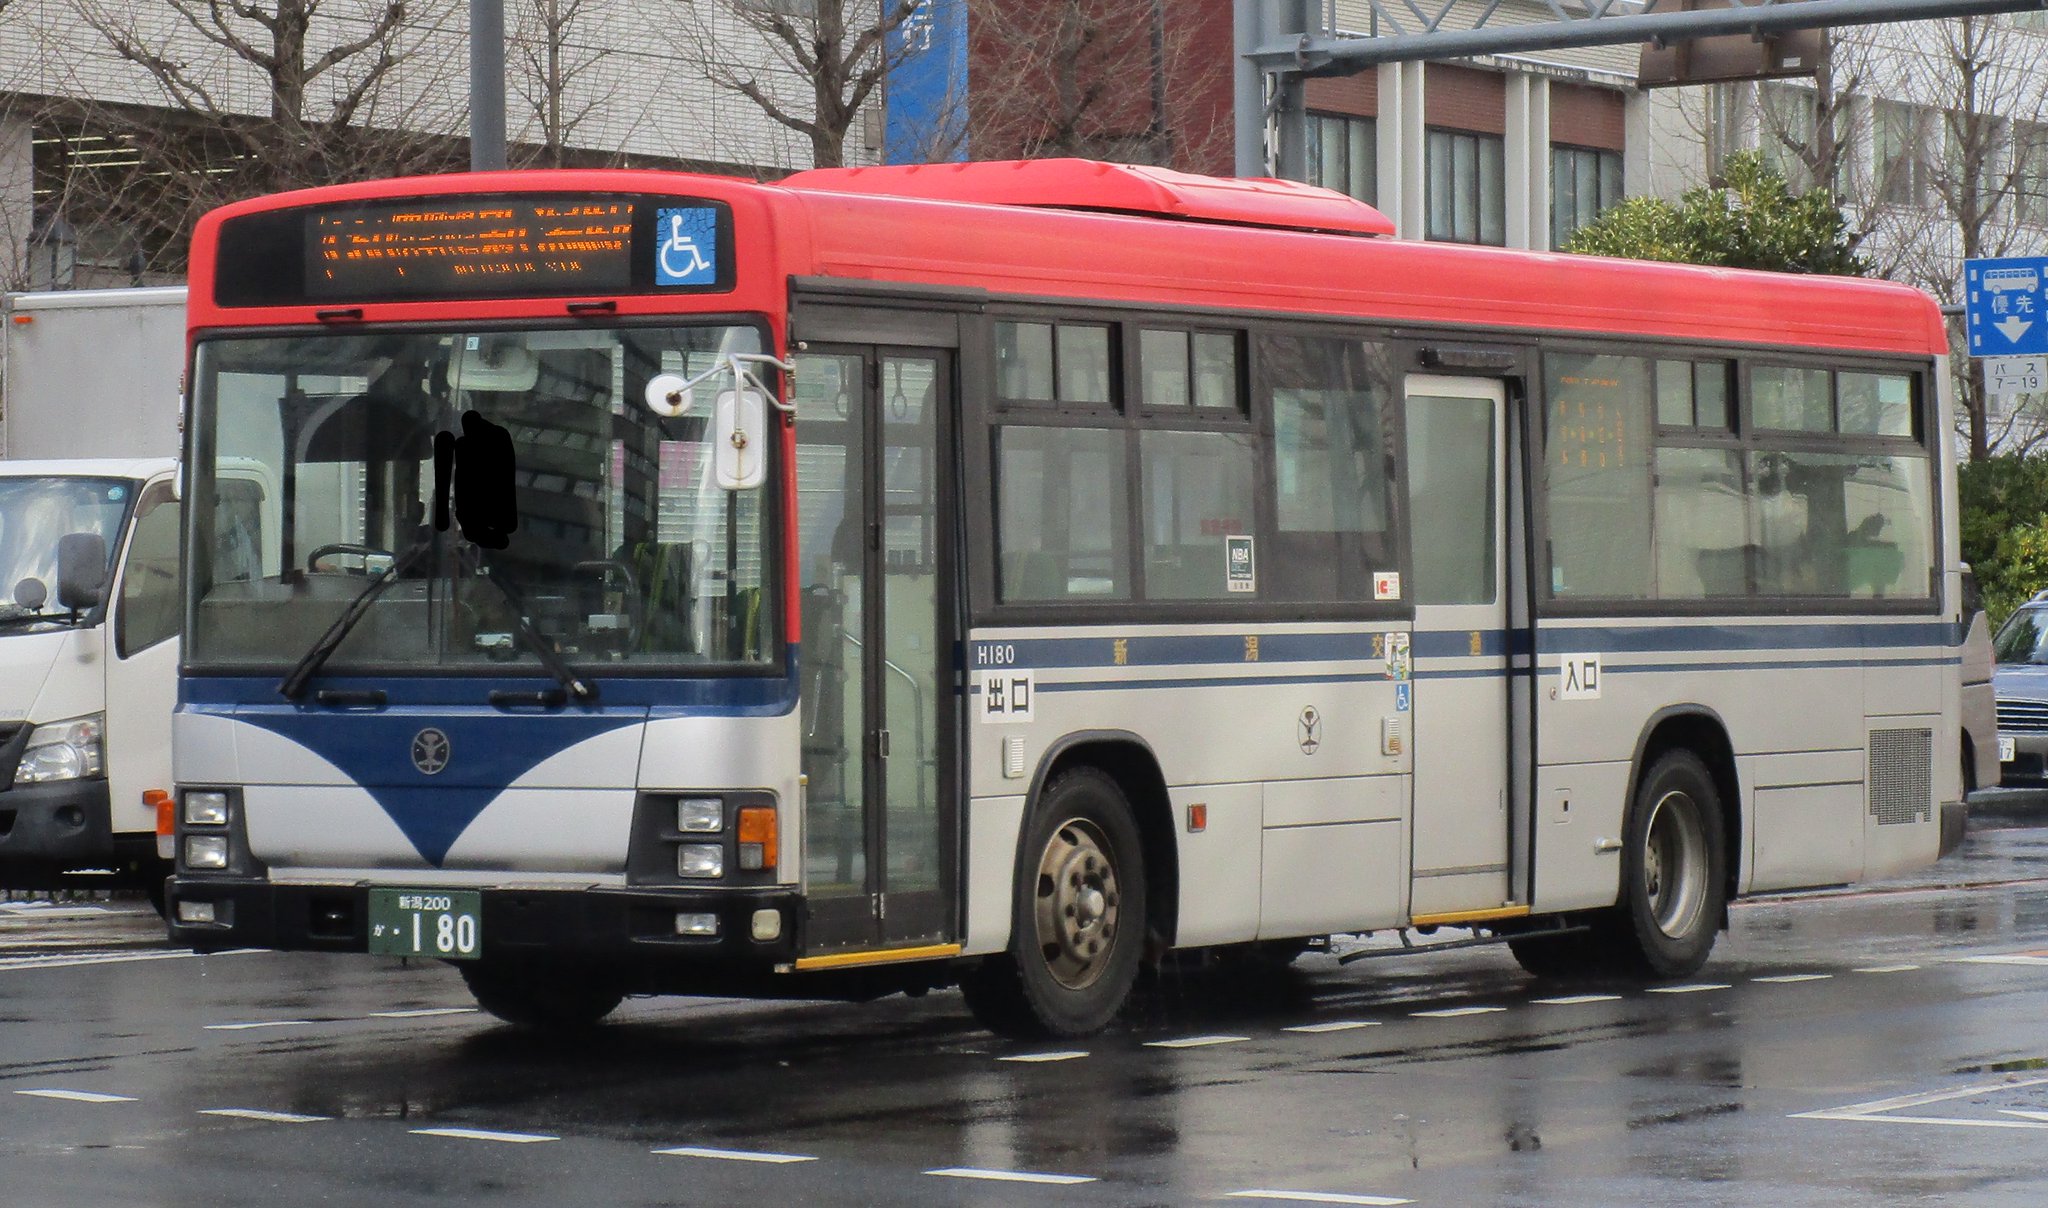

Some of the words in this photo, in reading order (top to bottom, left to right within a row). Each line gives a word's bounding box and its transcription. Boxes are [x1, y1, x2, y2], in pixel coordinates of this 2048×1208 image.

[1991, 295, 2035, 315] 優先
[1995, 363, 2037, 375] バス
[1995, 376, 2038, 389] 7-19
[1232, 548, 1249, 560] NBA
[978, 645, 1015, 664] H180
[1566, 661, 1597, 691] 入口
[987, 678, 1028, 713] 出口
